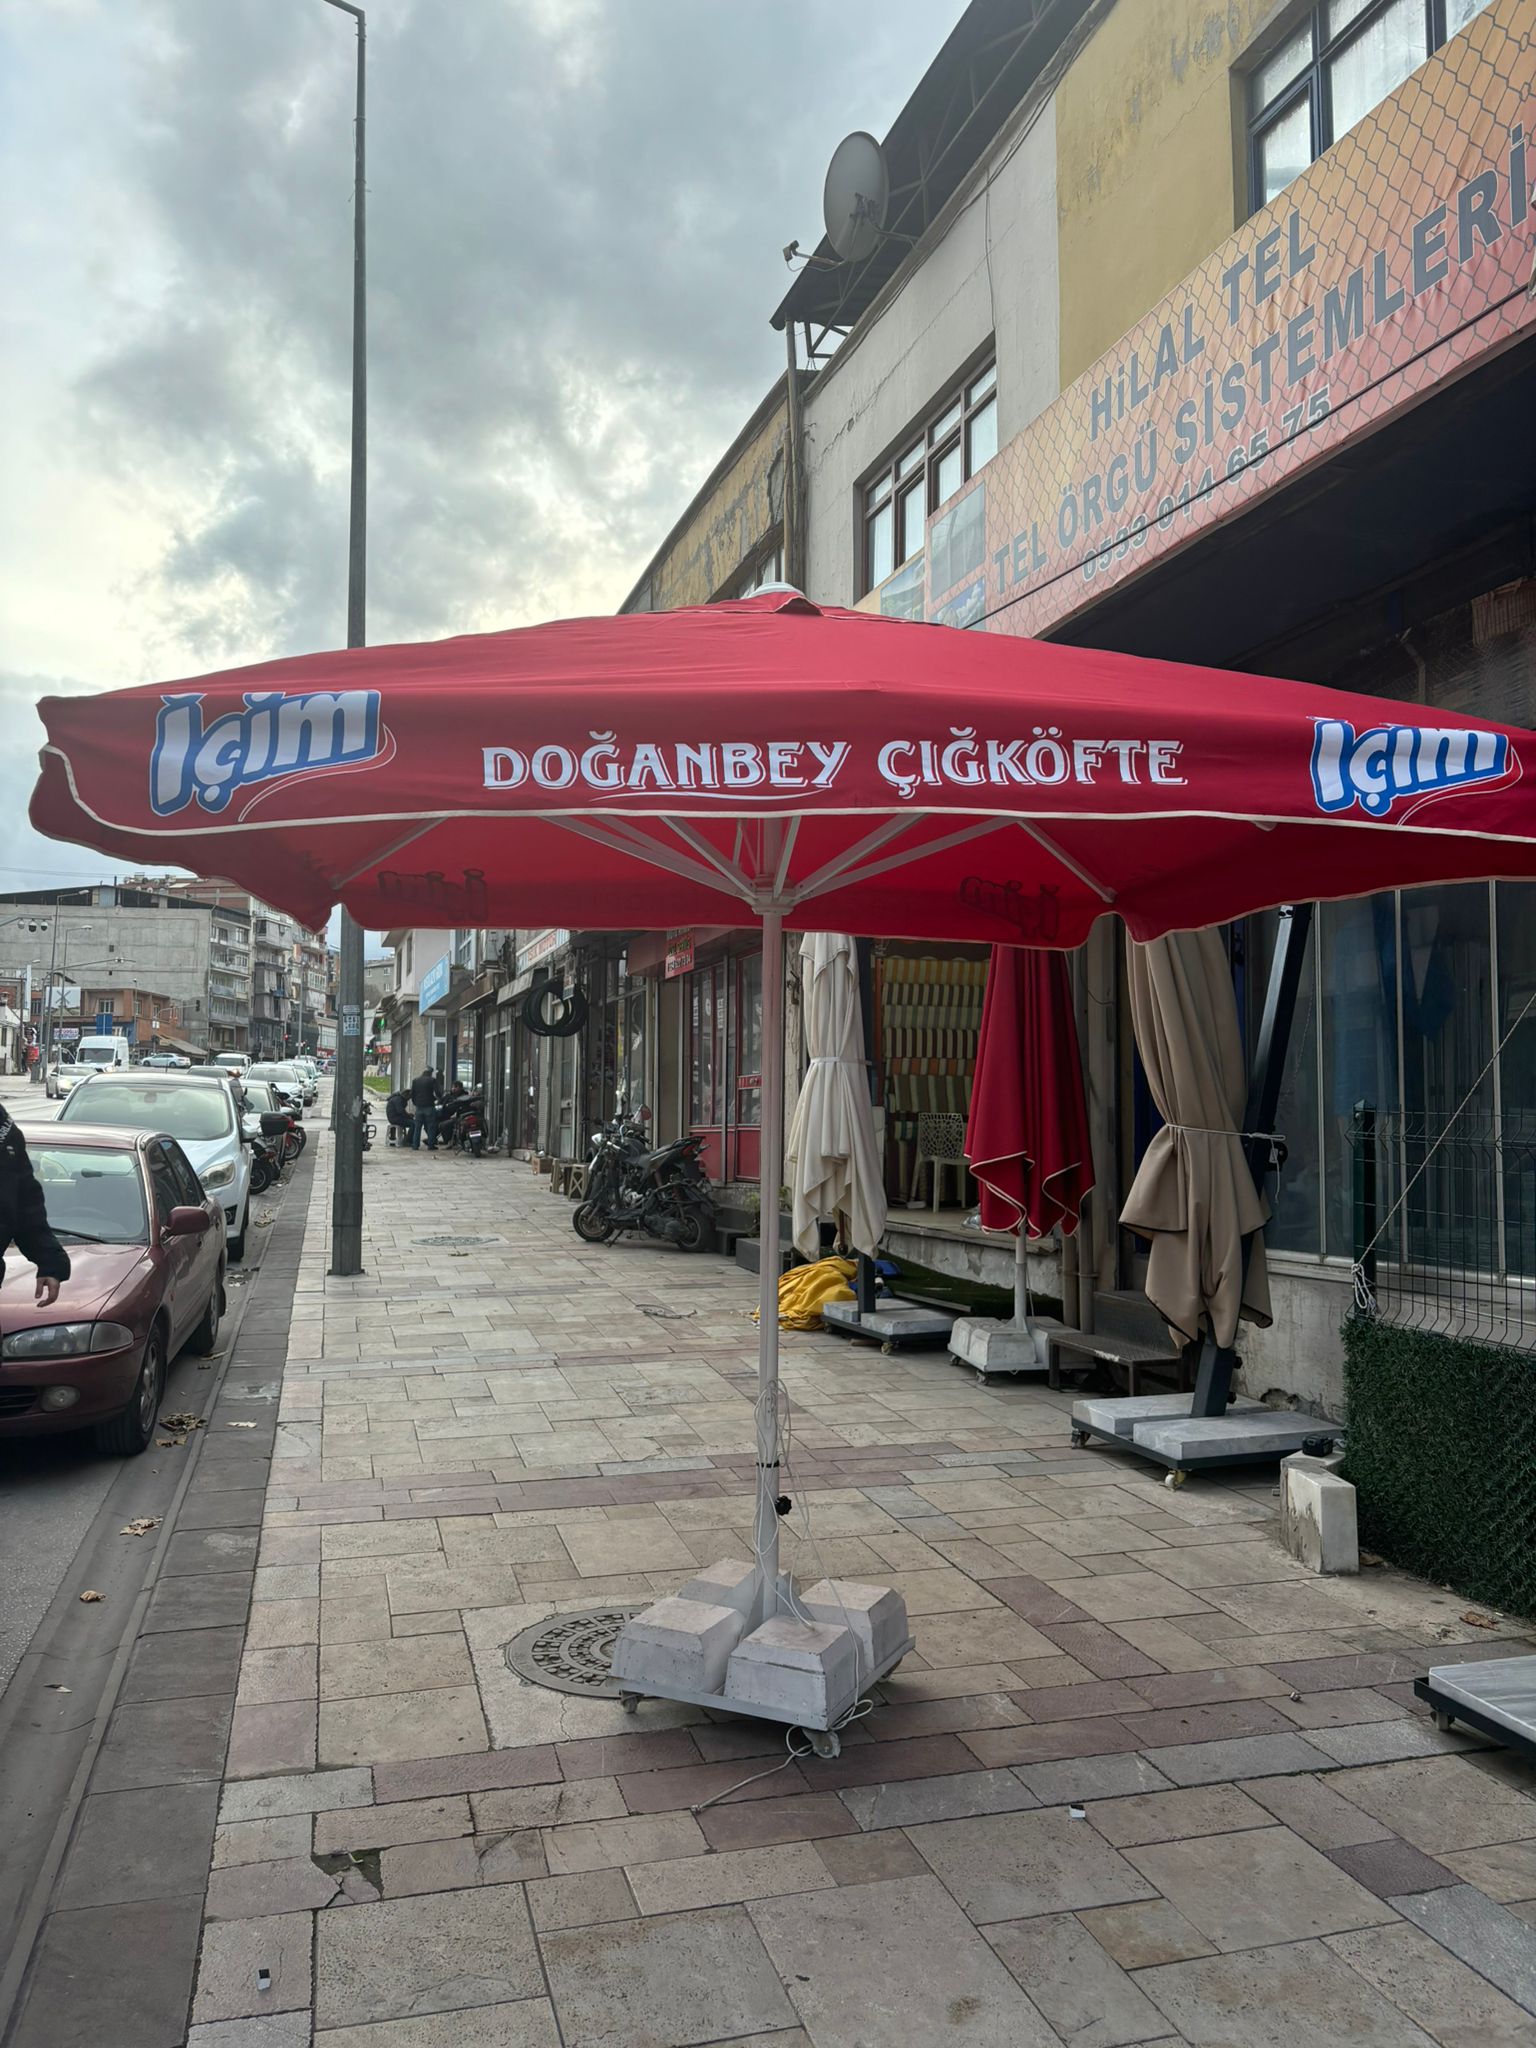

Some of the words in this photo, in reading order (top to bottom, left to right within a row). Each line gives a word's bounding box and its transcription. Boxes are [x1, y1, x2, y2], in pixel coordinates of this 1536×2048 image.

[1221, 208, 1317, 328] TEL
[992, 520, 1049, 597] TEL
[1057, 417, 1158, 550] ÖRGÜ
[1173, 121, 1529, 466] SİSTEMLERİ
[1081, 511, 1150, 583] 0533
[1157, 464, 1217, 533] 014
[1225, 427, 1270, 486] 65
[1280, 384, 1333, 450] 75
[481, 729, 852, 791] DOĞANBEY
[876, 726, 1189, 800] ÇIĞKÖFTE
